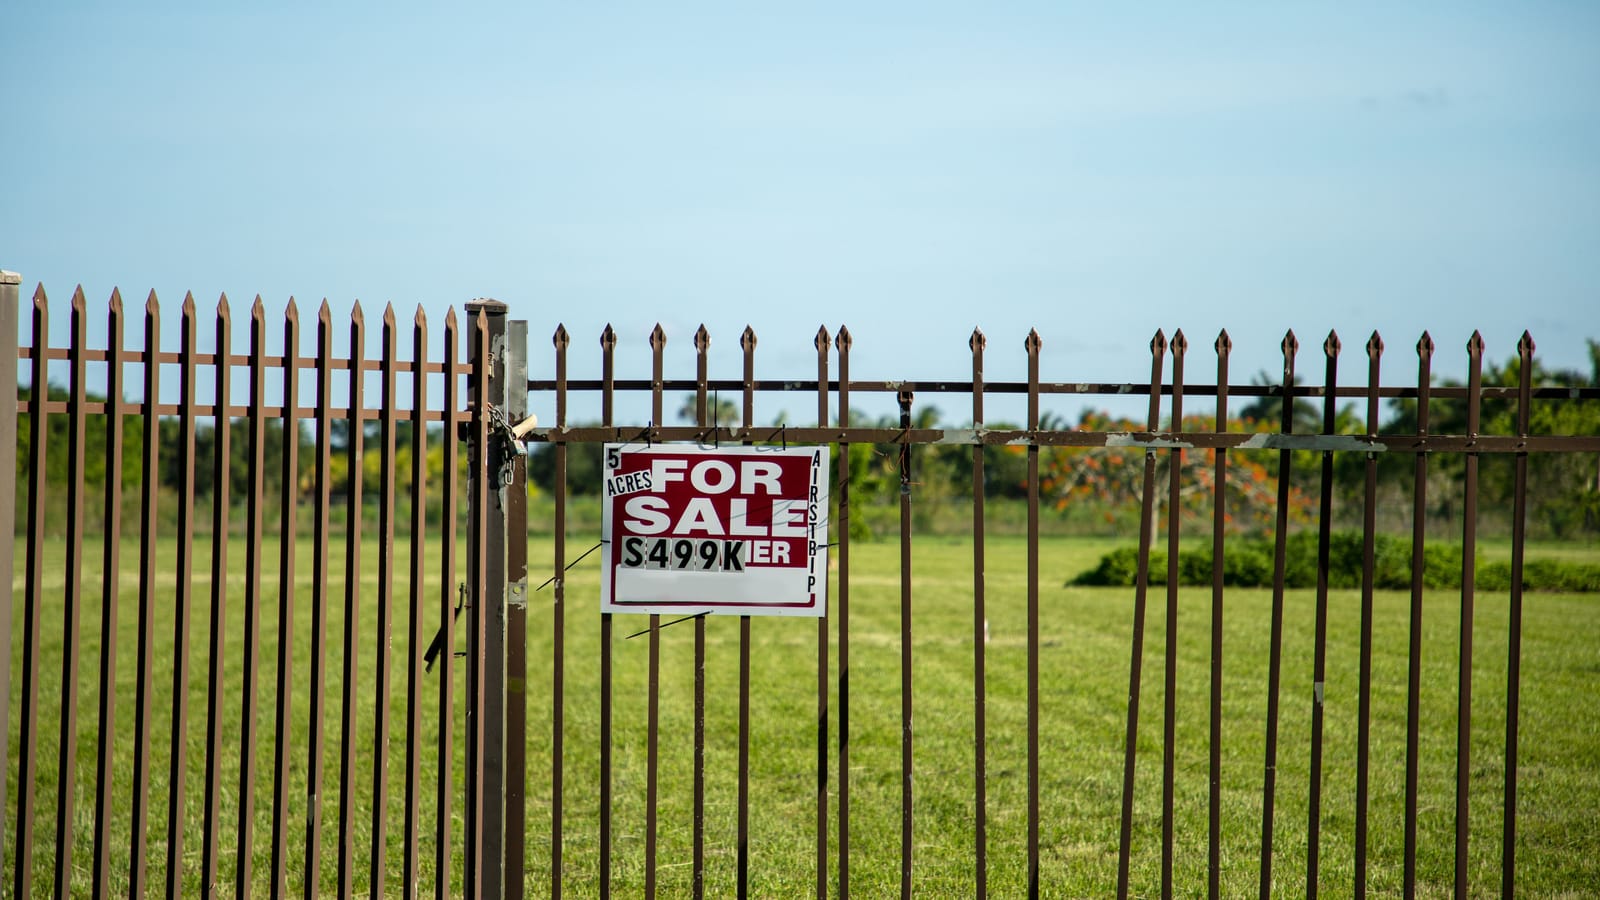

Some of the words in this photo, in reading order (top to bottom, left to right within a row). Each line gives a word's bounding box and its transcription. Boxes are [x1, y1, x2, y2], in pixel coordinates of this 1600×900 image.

[608, 448, 619, 468] 5
[607, 471, 652, 496] ACRES
[651, 459, 783, 495] FOR
[623, 496, 808, 538] SALE
